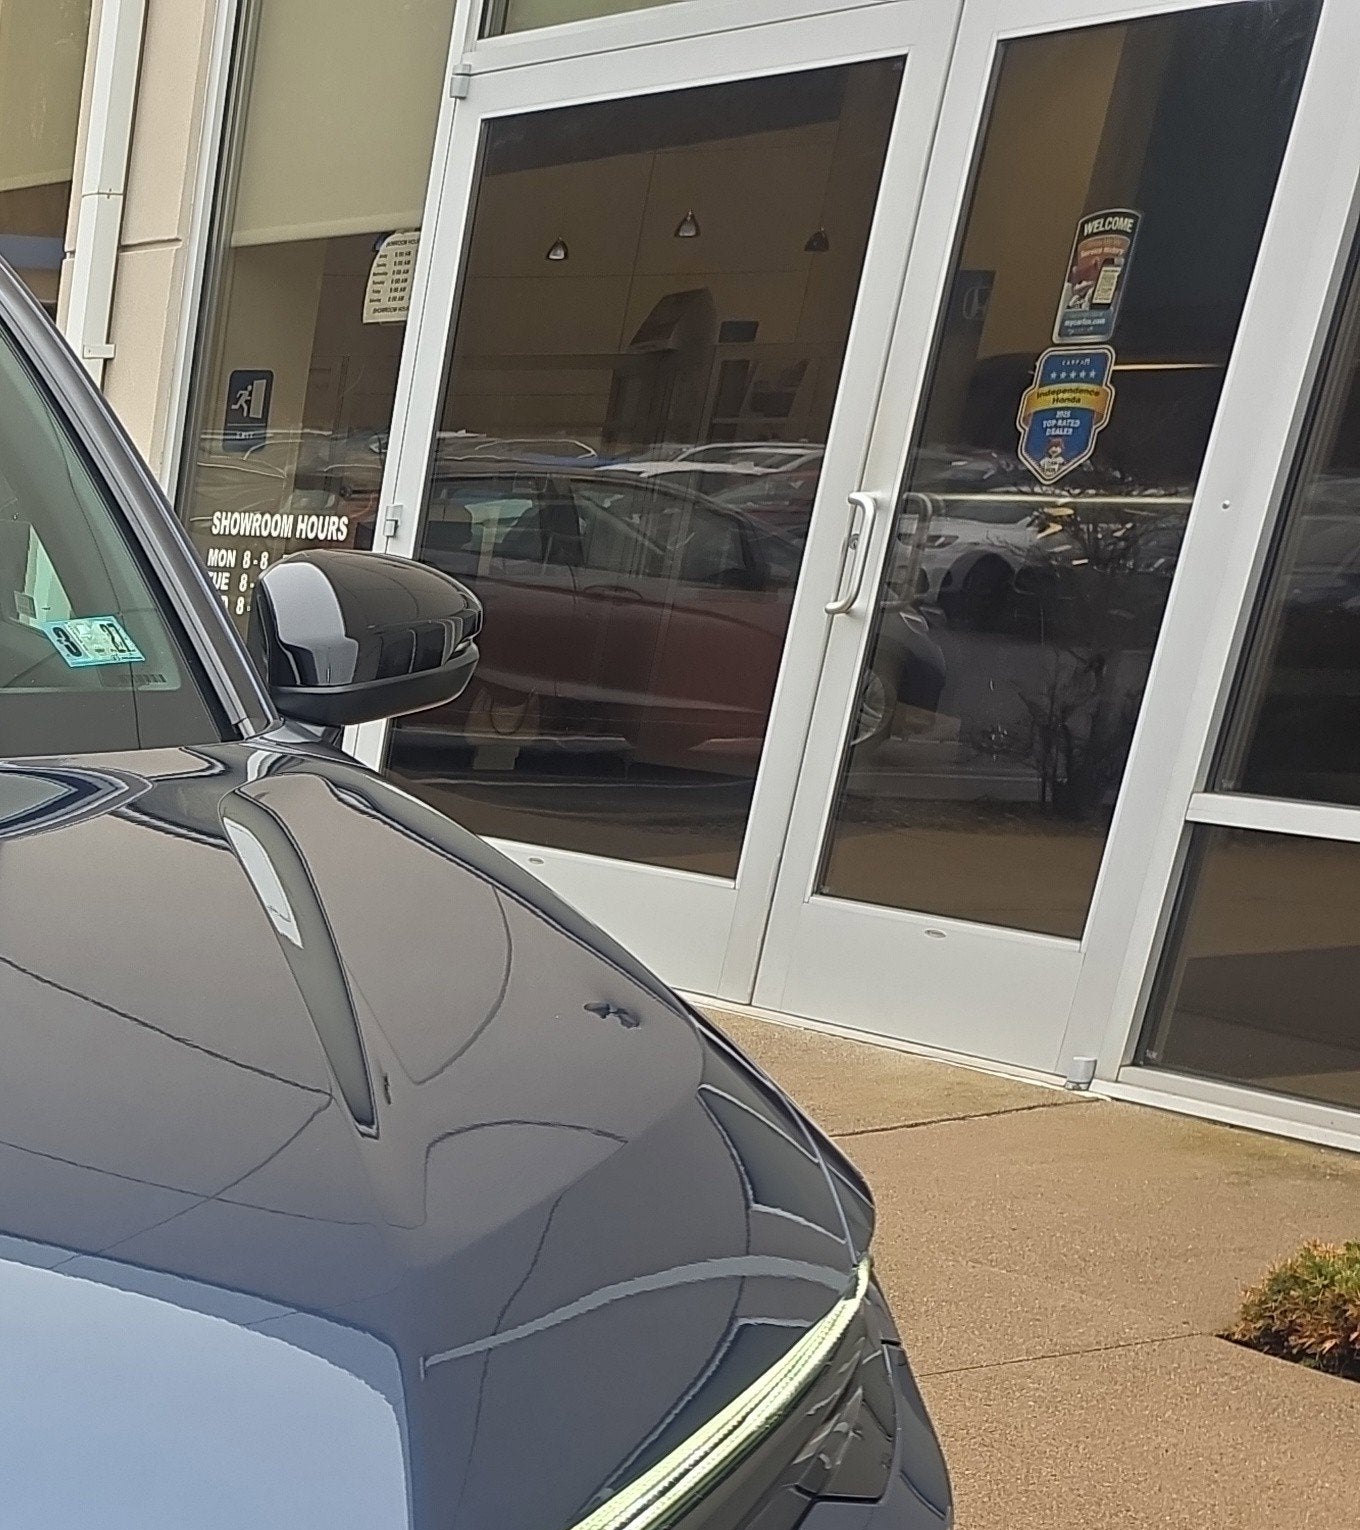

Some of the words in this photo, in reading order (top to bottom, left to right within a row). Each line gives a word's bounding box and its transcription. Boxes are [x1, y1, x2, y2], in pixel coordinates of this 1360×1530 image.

[1083, 216, 1134, 236] WELCOME
[1036, 387, 1101, 400] Independence
[1052, 396, 1082, 405] Honda
[1045, 427, 1074, 436] DEALER
[211, 511, 294, 539] SHOWROOM
[295, 514, 349, 542] HOURS
[207, 548, 237, 568] MON
[52, 626, 83, 658] 3
